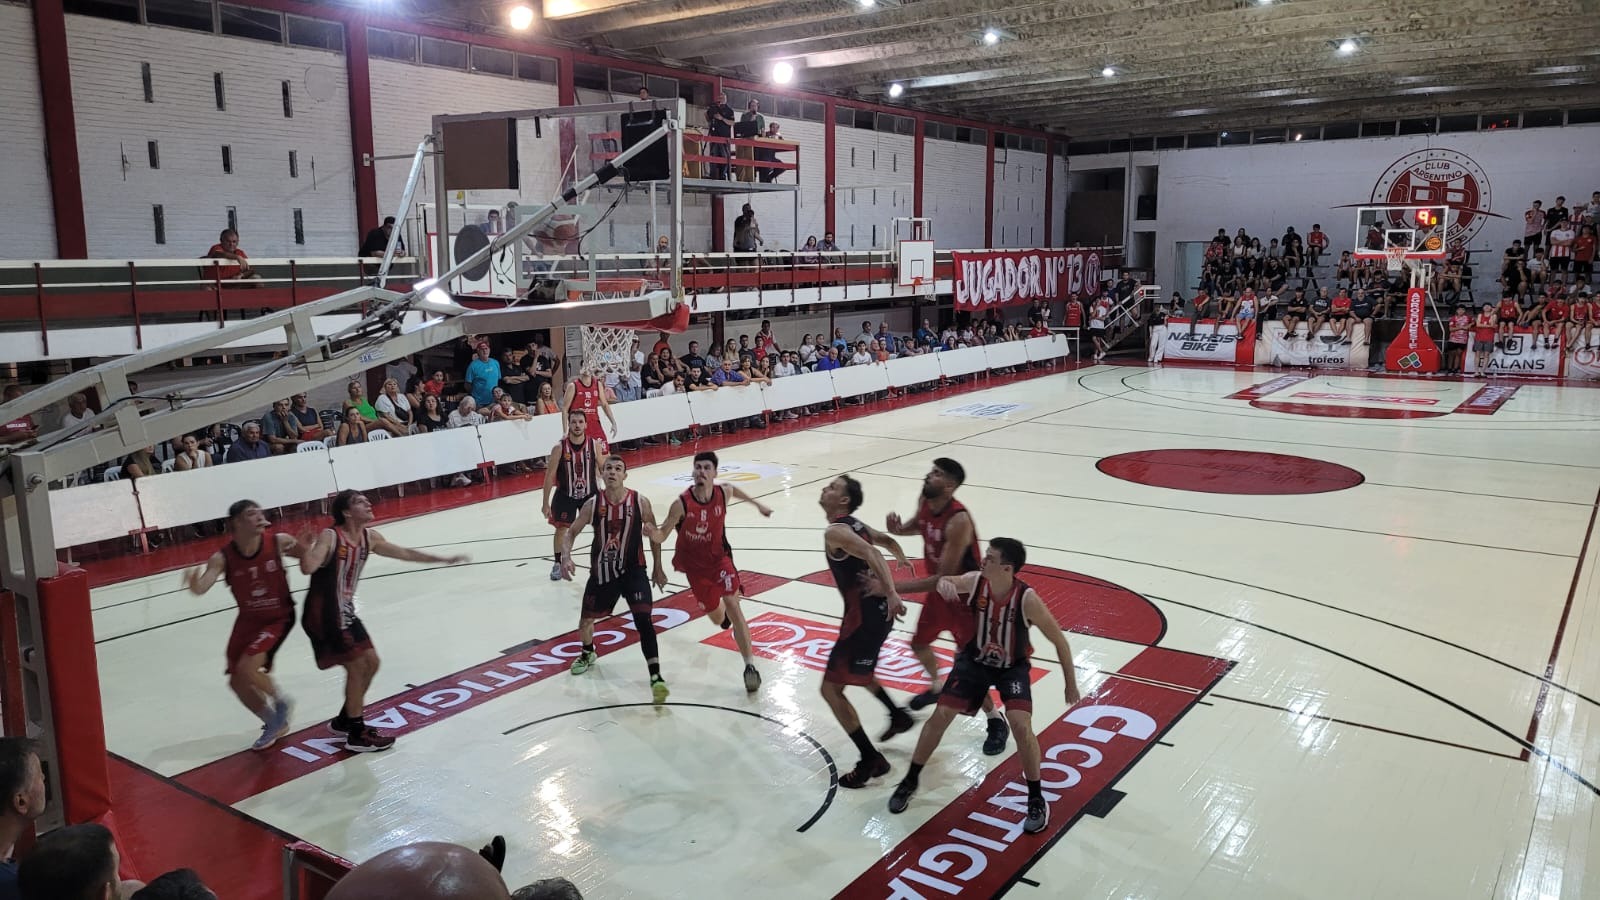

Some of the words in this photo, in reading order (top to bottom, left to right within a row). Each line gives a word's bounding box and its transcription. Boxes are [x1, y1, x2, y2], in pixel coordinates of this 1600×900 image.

[1425, 162, 1451, 170] CLUB
[1413, 167, 1463, 181] ARGENTINO
[956, 254, 1044, 306] JUGADOR
[1066, 253, 1084, 294] 13
[1168, 332, 1236, 343] NACHOS
[1181, 342, 1219, 352] BIKE
[281, 630, 627, 763] CONTIGIANI
